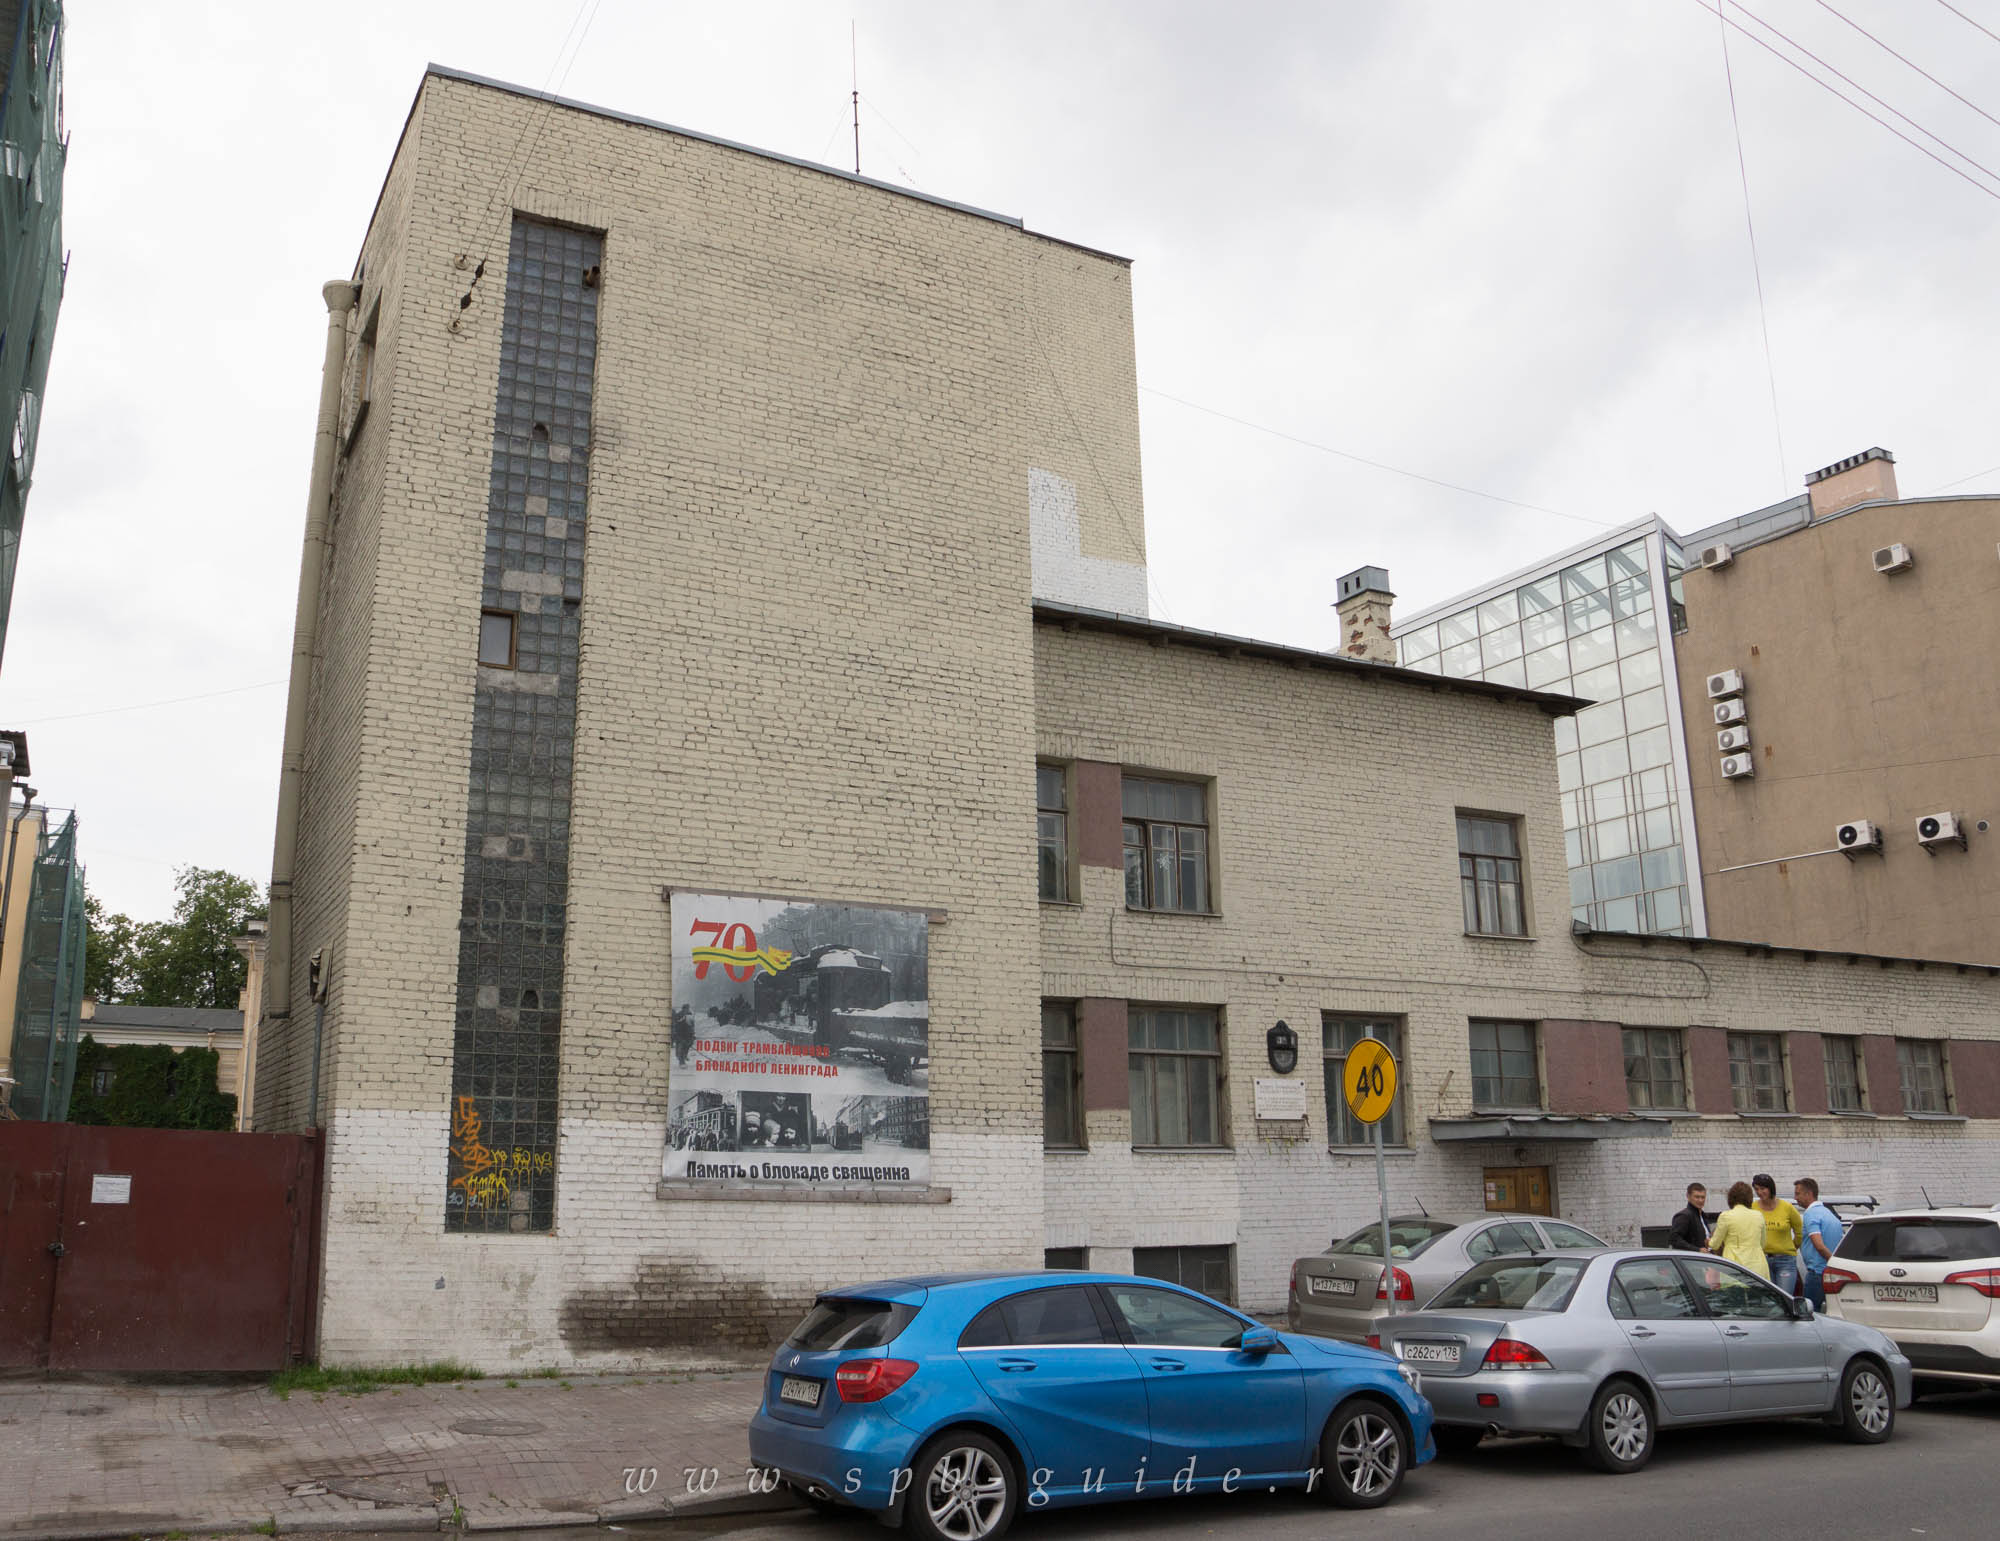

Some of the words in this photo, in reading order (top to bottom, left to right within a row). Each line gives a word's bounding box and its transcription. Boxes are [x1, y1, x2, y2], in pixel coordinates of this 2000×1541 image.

[690, 917, 757, 983] 70
[696, 1039, 739, 1054] ПОДВИГ
[696, 1060, 767, 1075] БЛОКАДНОГО
[770, 1063, 839, 1078] ЛЕНИНГРАДА
[1356, 1064, 1384, 1098] 40
[686, 1161, 747, 1179] Память
[749, 1164, 759, 1179] о
[762, 1162, 829, 1182] блокаде
[831, 1166, 910, 1181] священна
[1890, 1268, 1905, 1277] KIA
